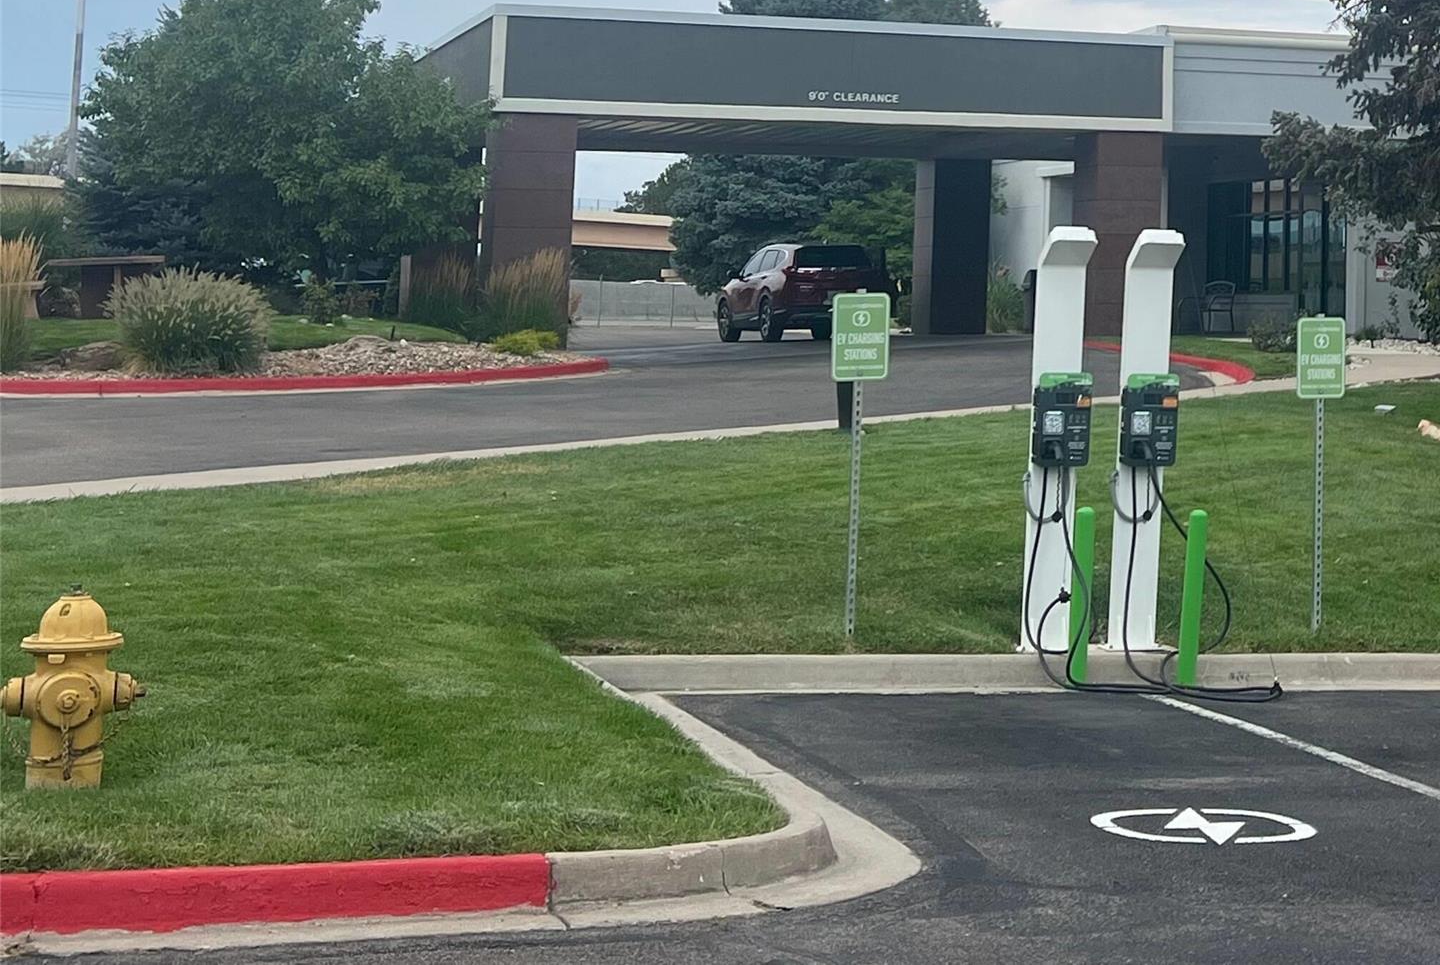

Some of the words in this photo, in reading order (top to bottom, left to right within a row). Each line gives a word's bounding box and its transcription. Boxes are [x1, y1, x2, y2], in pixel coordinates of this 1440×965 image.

[833, 92, 899, 103] CLEARANCE
[837, 333, 846, 345] EV
[848, 333, 885, 344] CHARGING
[844, 348, 878, 361] STATIONS
